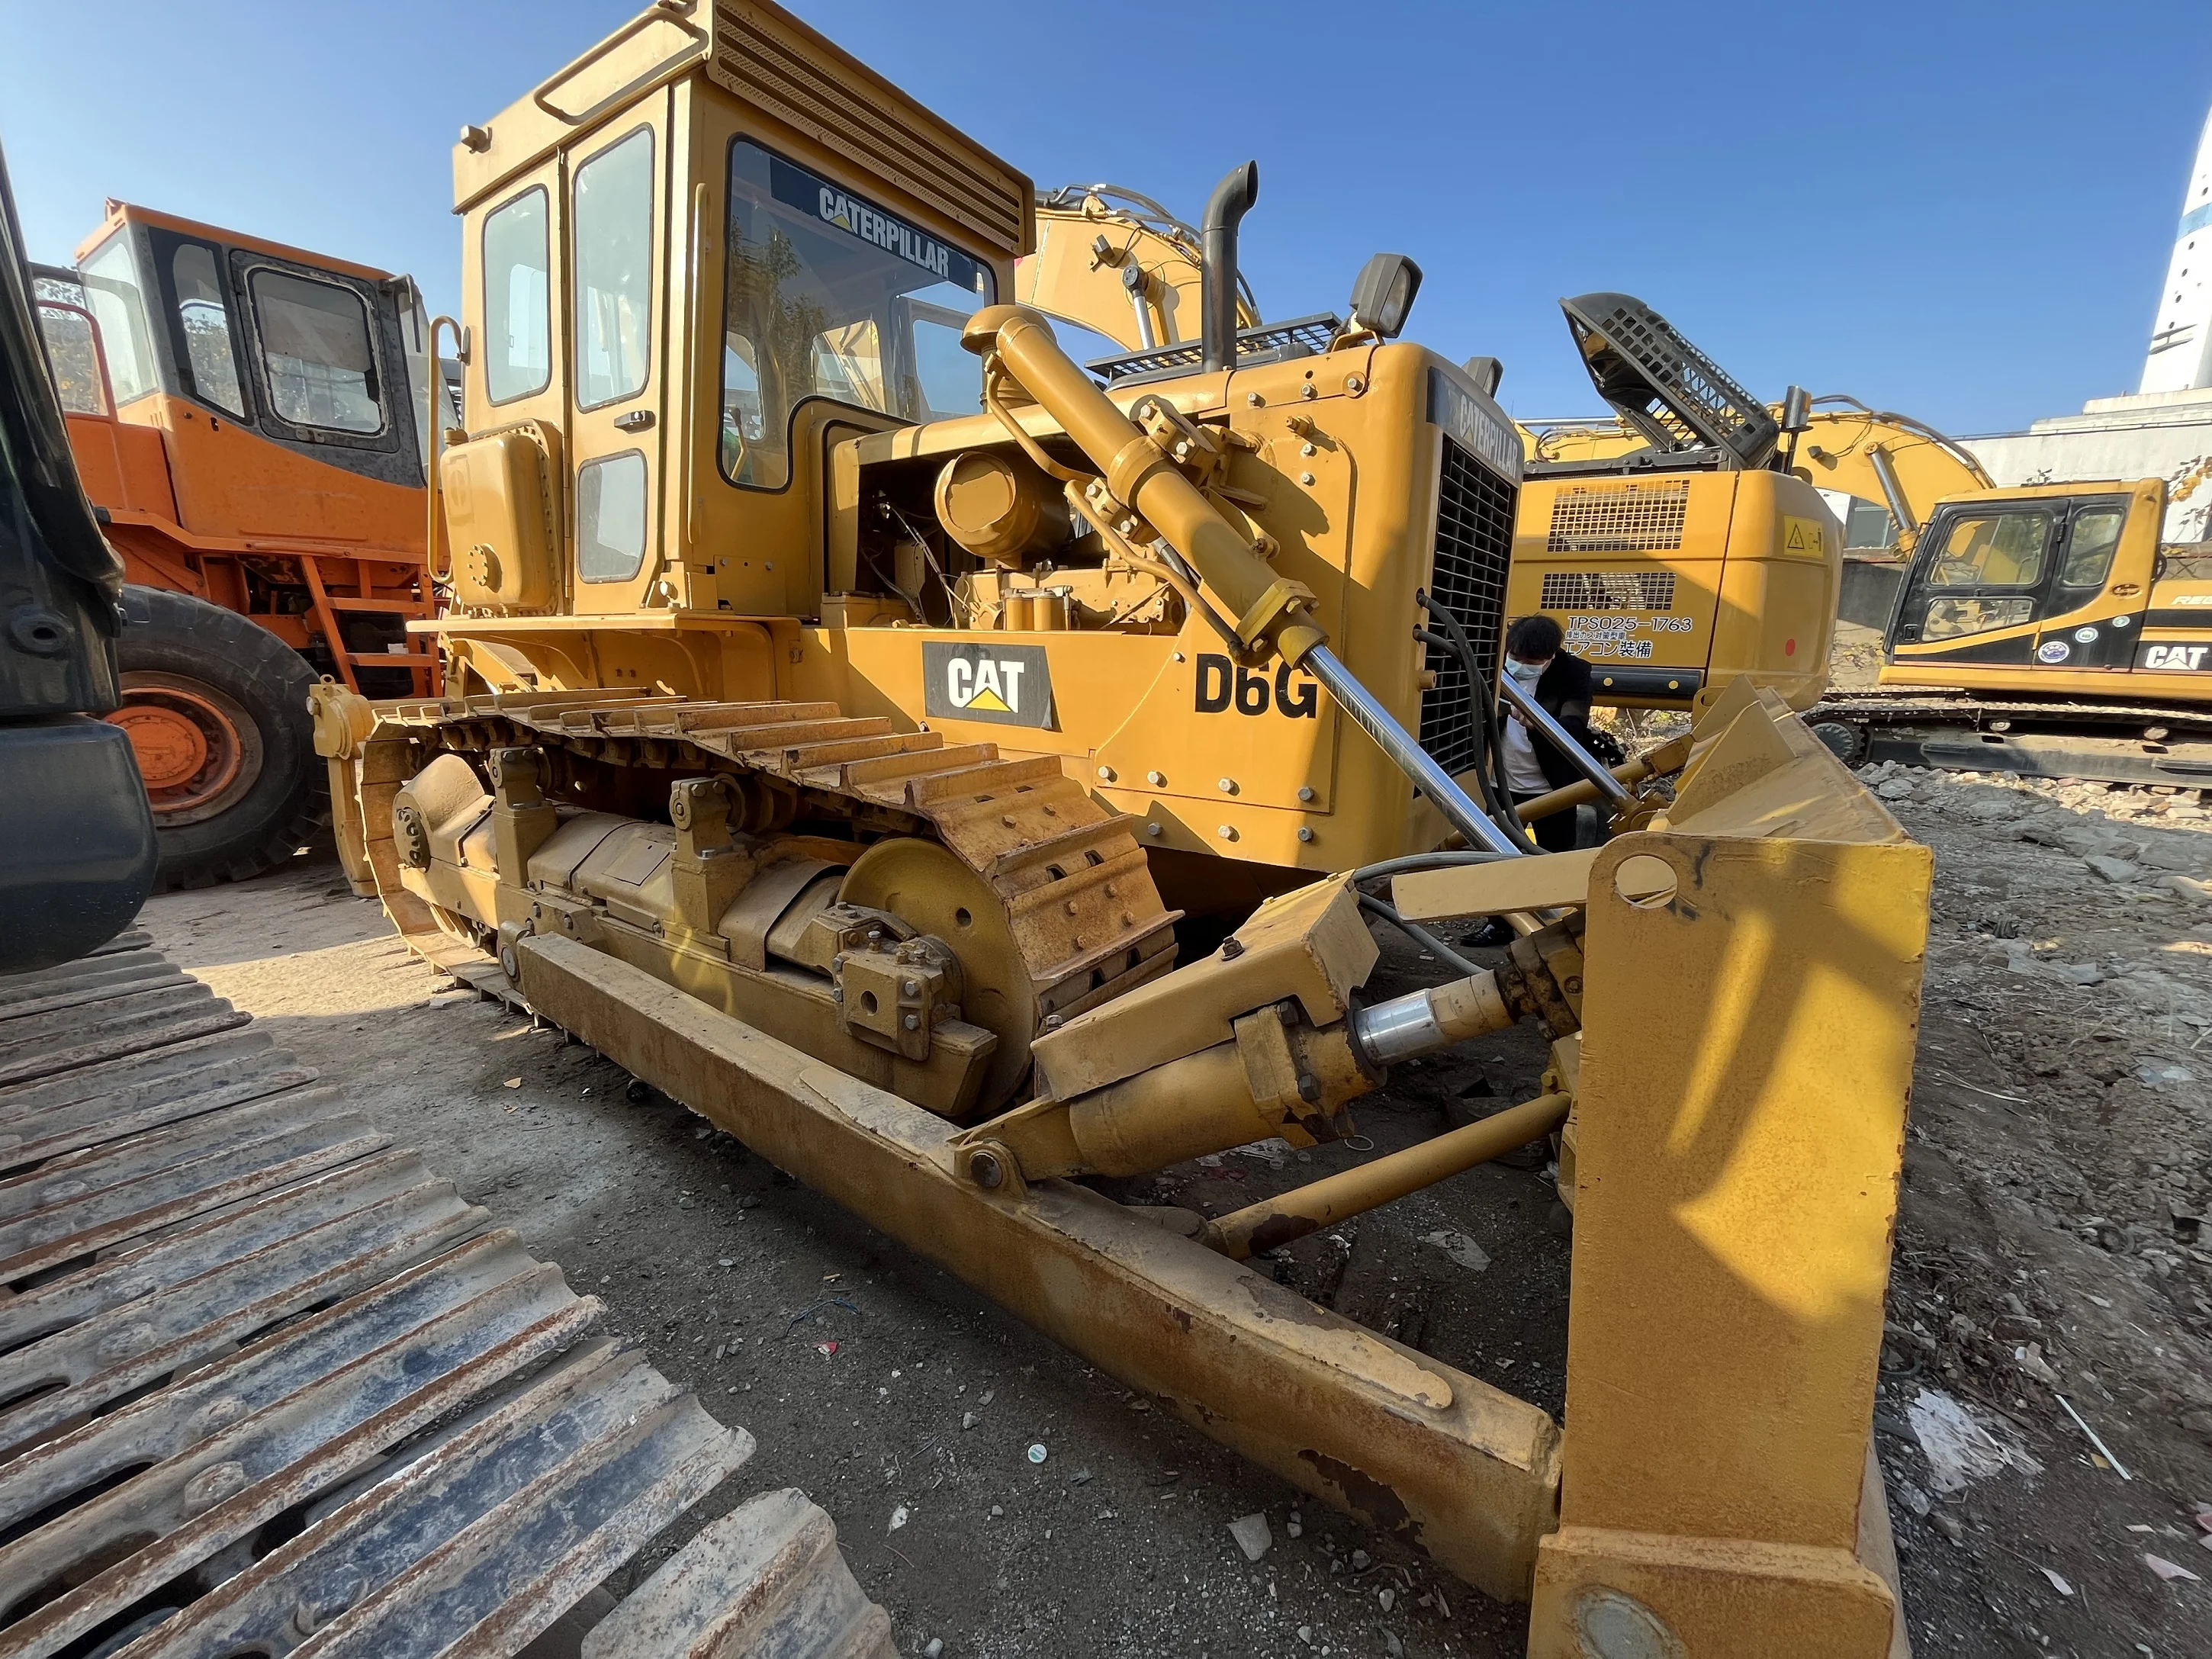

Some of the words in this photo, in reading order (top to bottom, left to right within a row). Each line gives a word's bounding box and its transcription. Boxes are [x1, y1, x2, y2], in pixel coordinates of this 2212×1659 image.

[818, 187, 950, 278] CATERPILLAR
[1459, 394, 1519, 479] CATERPILLAR
[947, 657, 1025, 714] CAT
[1195, 653, 1317, 719] D6G
[2145, 646, 2209, 670] CAT
